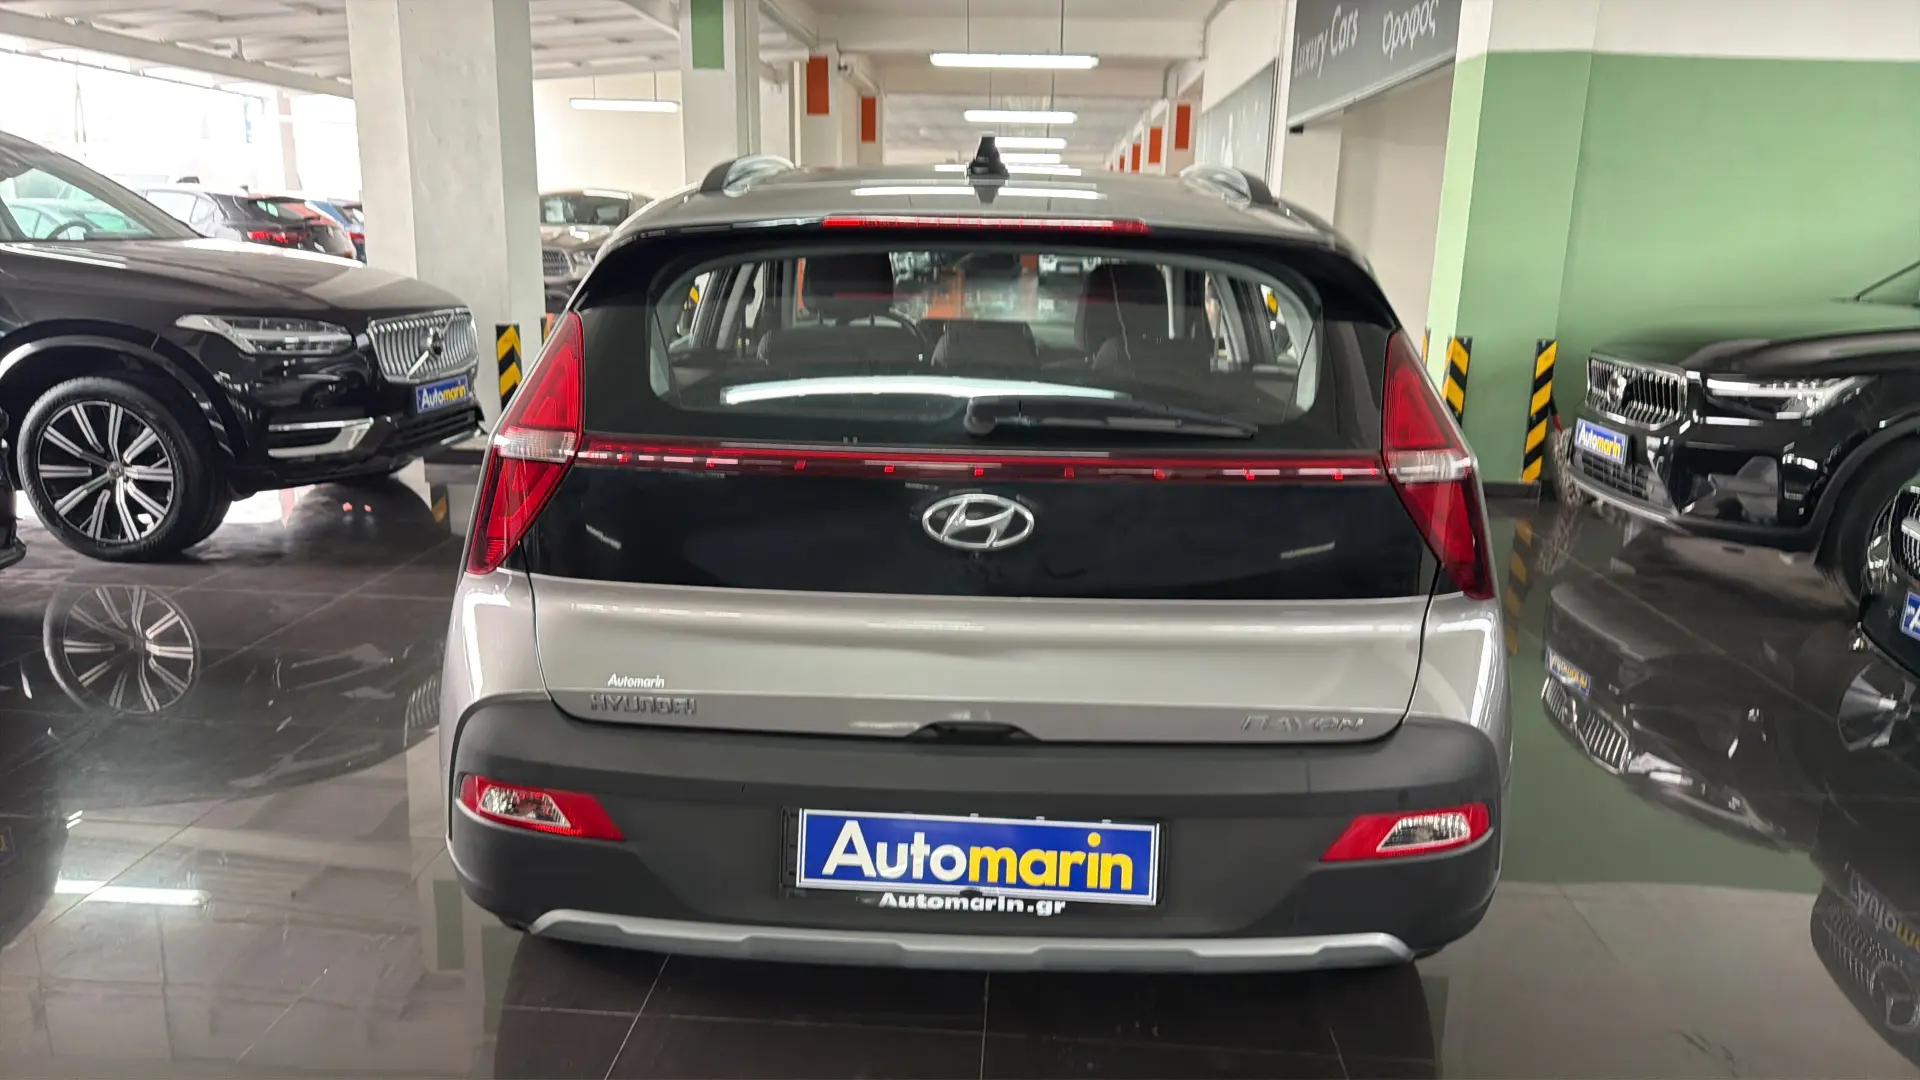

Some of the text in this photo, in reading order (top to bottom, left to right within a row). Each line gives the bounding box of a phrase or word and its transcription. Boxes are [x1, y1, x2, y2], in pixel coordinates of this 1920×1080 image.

[1330, 4, 1359, 57] Cars
[421, 380, 466, 409] Automarin
[1578, 422, 1622, 460] Automarin
[607, 673, 665, 689] Automarin
[821, 819, 1134, 890] Automarin
[878, 891, 1066, 917] Automarin.gr
